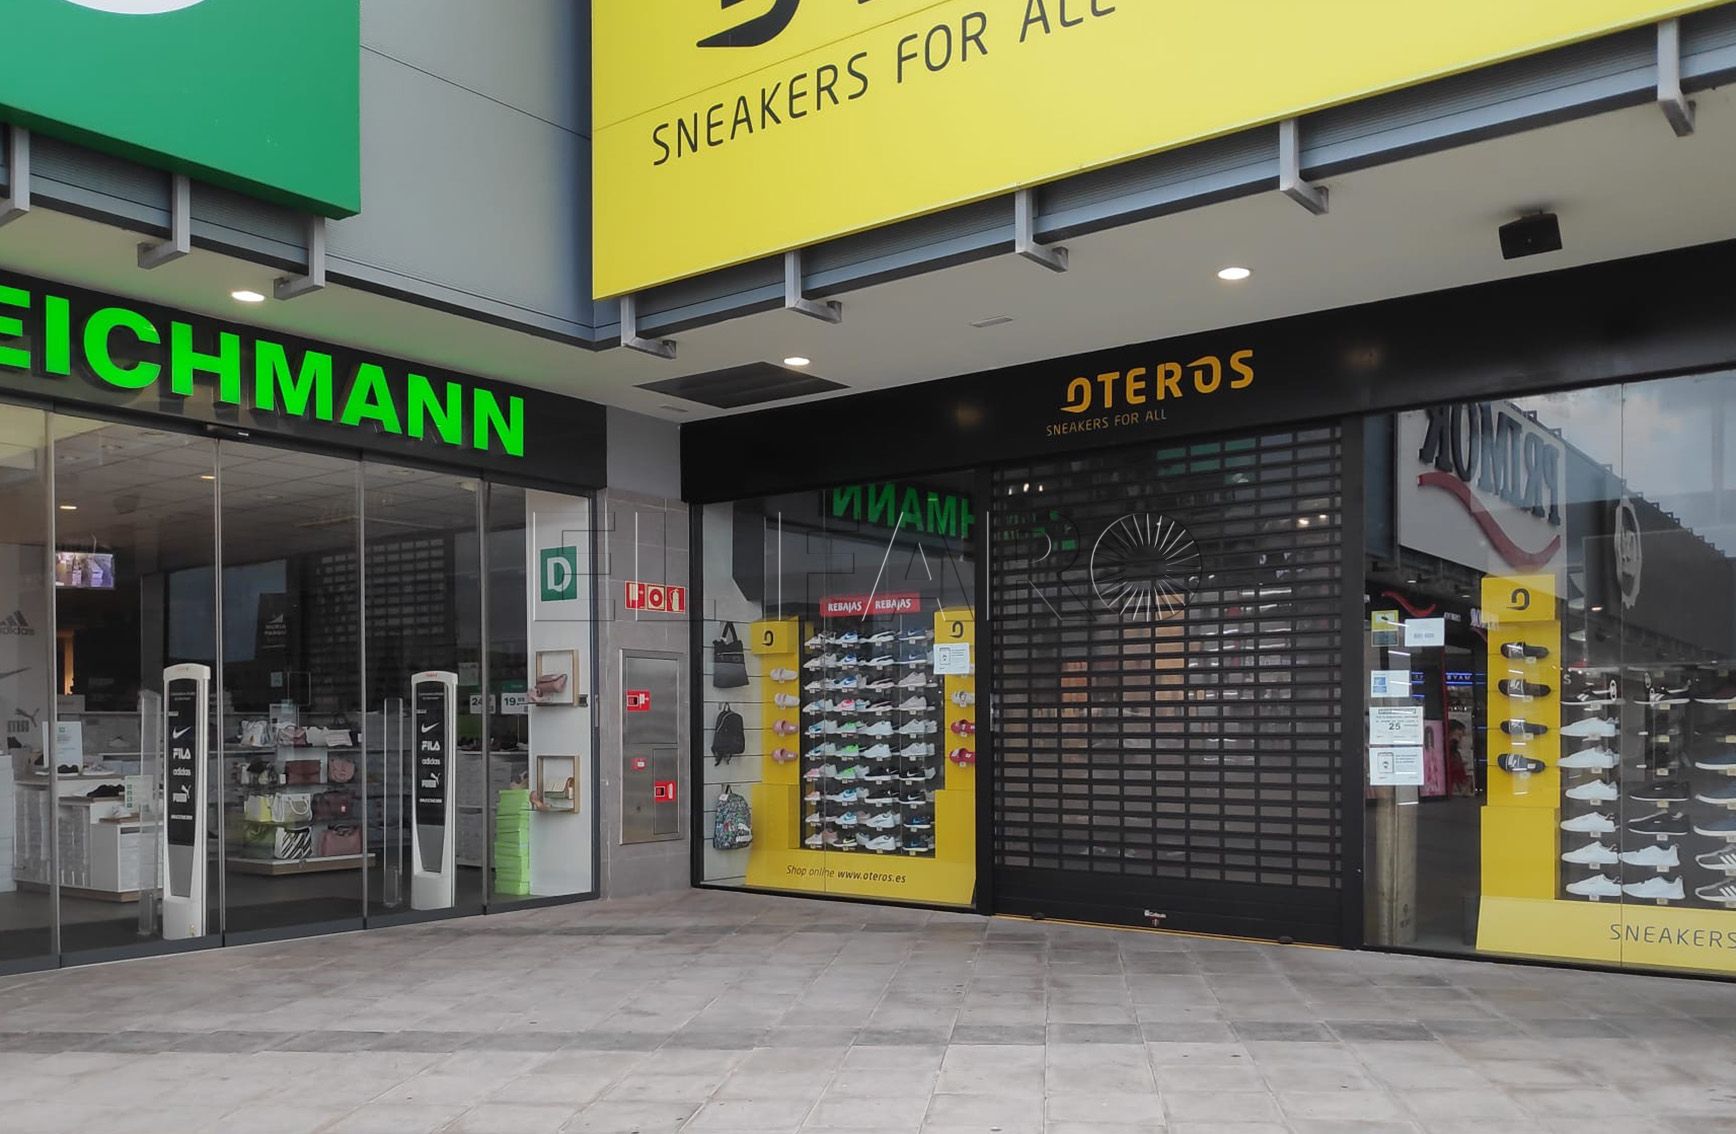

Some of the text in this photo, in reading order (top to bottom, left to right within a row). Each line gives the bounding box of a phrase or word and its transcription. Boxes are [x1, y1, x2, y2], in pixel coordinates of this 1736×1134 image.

[653, 52, 868, 166] SNEAKERS
[897, 11, 988, 84] FOR
[1060, 349, 1254, 413] OTEROS
[1046, 408, 1167, 437] SNEAKERS FOR ALL
[547, 556, 573, 592] D
[828, 598, 912, 613] REBAJAS REBAJAS
[173, 748, 191, 760] FILA
[422, 740, 440, 751] FILA
[786, 865, 906, 883] Shop online www.oteros.es
[1610, 924, 1736, 949] SNEAKERS
